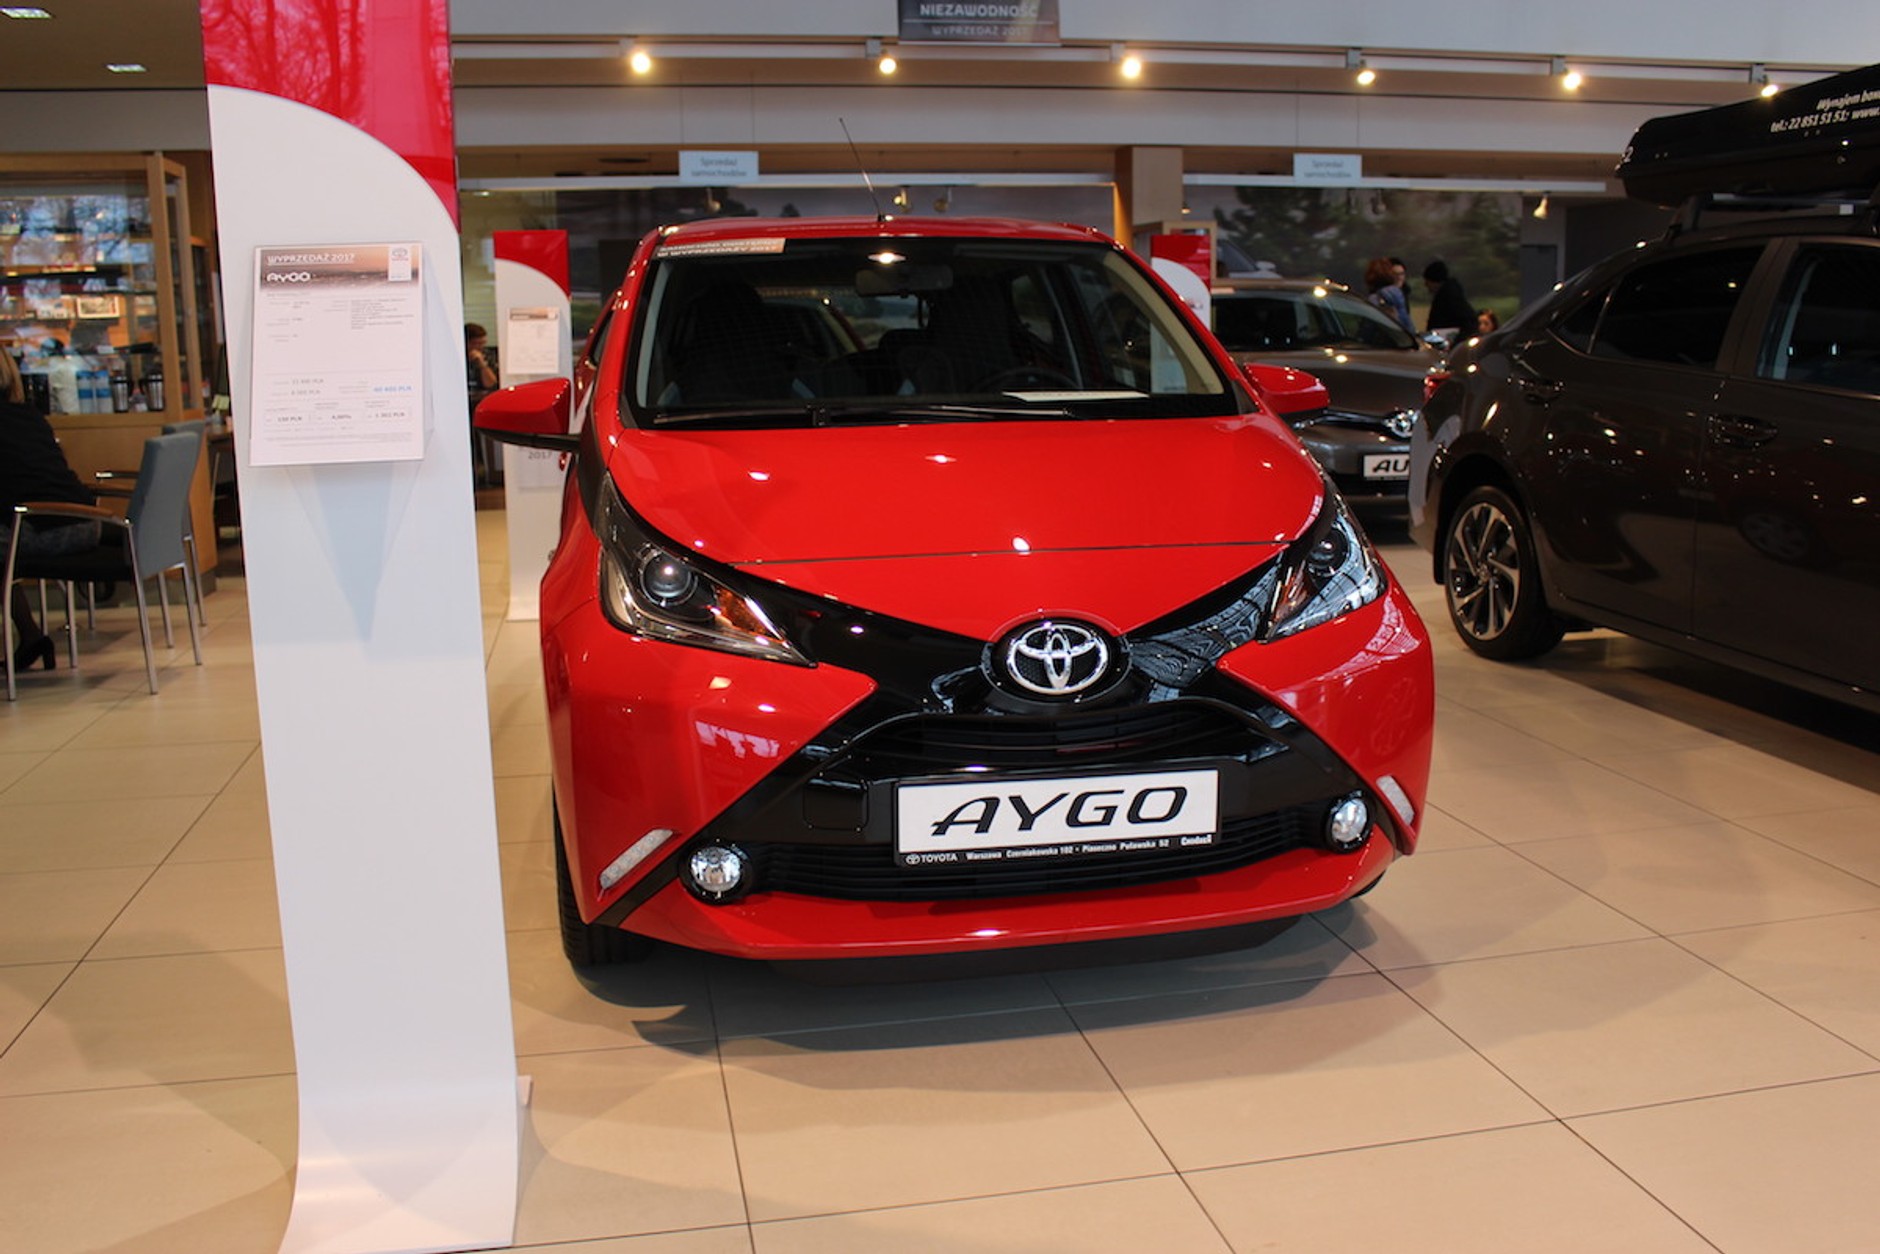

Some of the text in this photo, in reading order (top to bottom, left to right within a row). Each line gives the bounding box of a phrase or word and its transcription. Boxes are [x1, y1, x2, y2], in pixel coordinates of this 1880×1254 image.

[920, 3, 1038, 17] NIEZAWODNOŚĆ
[1788, 117, 1800, 130] 22
[1800, 114, 1820, 128] 851
[1820, 111, 1832, 125] 51
[267, 252, 355, 264] WYPRZEDAŻ 2017
[266, 271, 311, 282] AYGO
[528, 451, 552, 460] 2017
[930, 786, 1188, 837] AYGO
[921, 852, 958, 863] TOYOTA
[965, 850, 1002, 860] Warszawa
[1006, 847, 1059, 858] Czerniakowska
